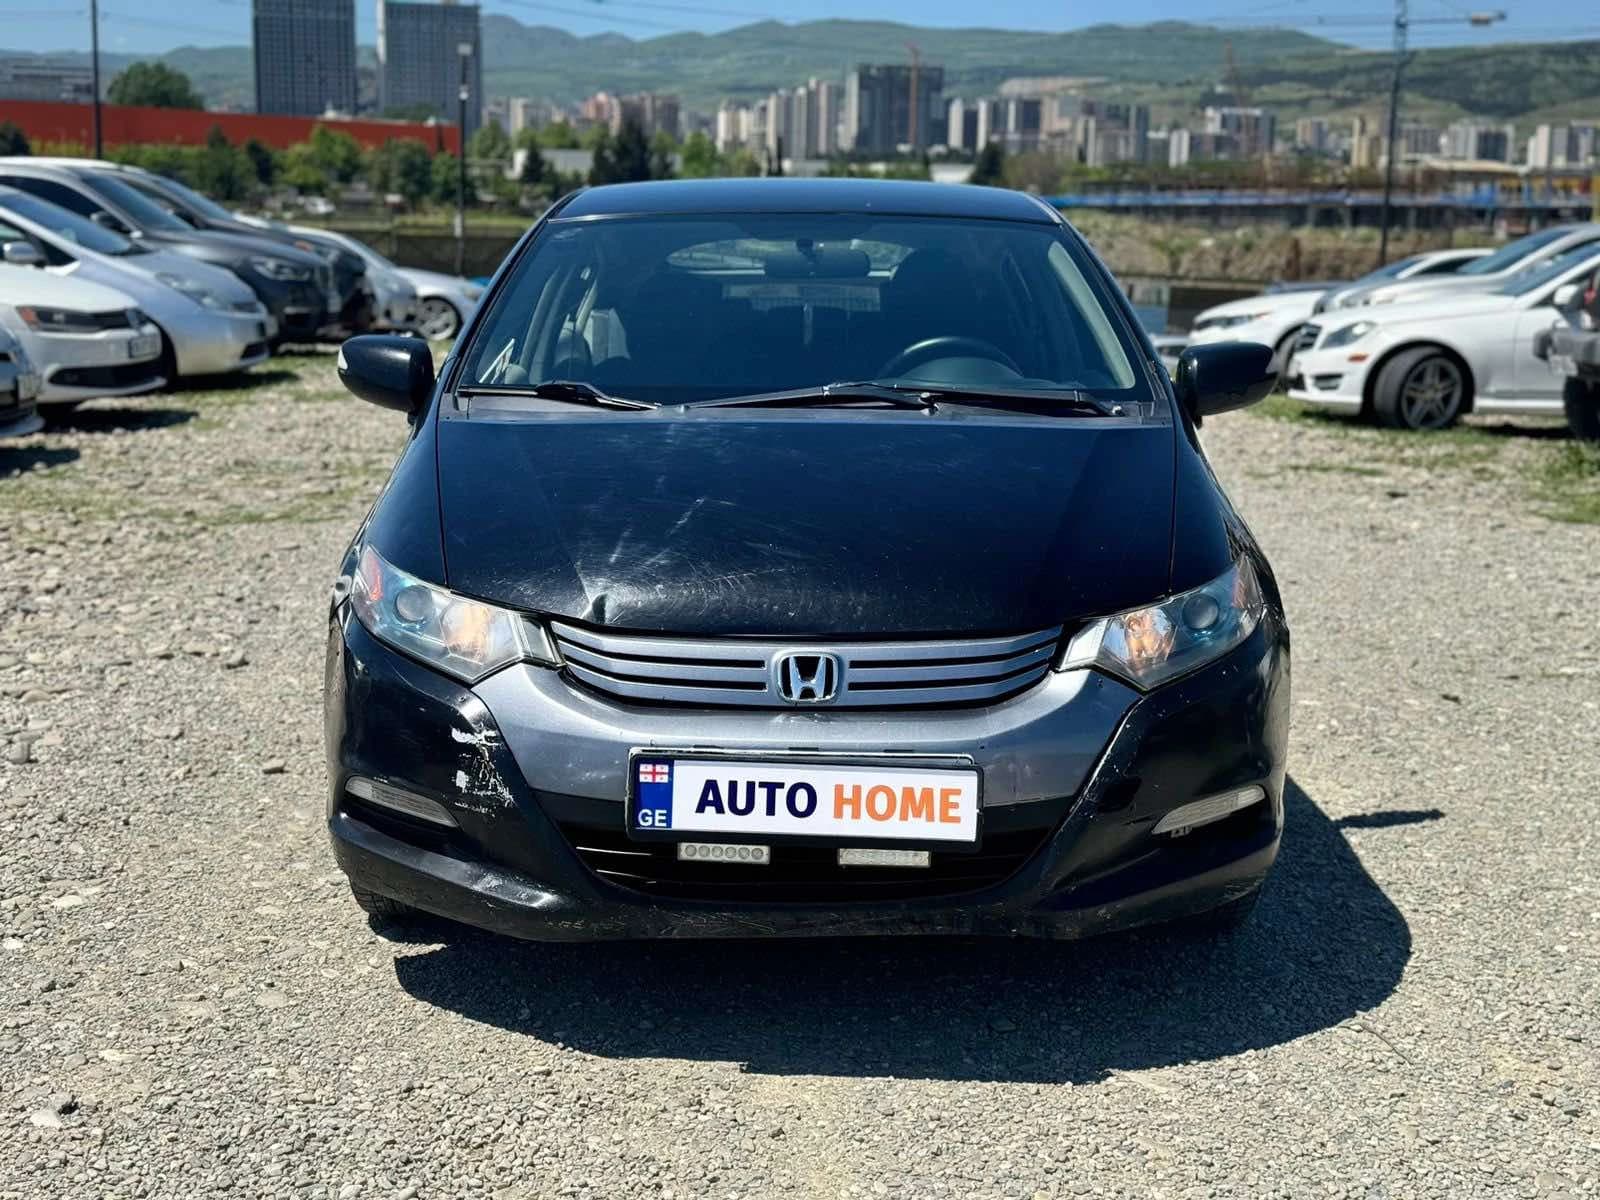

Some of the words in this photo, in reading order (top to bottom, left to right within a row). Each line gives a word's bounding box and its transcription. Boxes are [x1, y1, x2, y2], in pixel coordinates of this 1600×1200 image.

[638, 808, 667, 827] GE
[695, 779, 818, 819] AUTO
[833, 783, 963, 825] HOME
